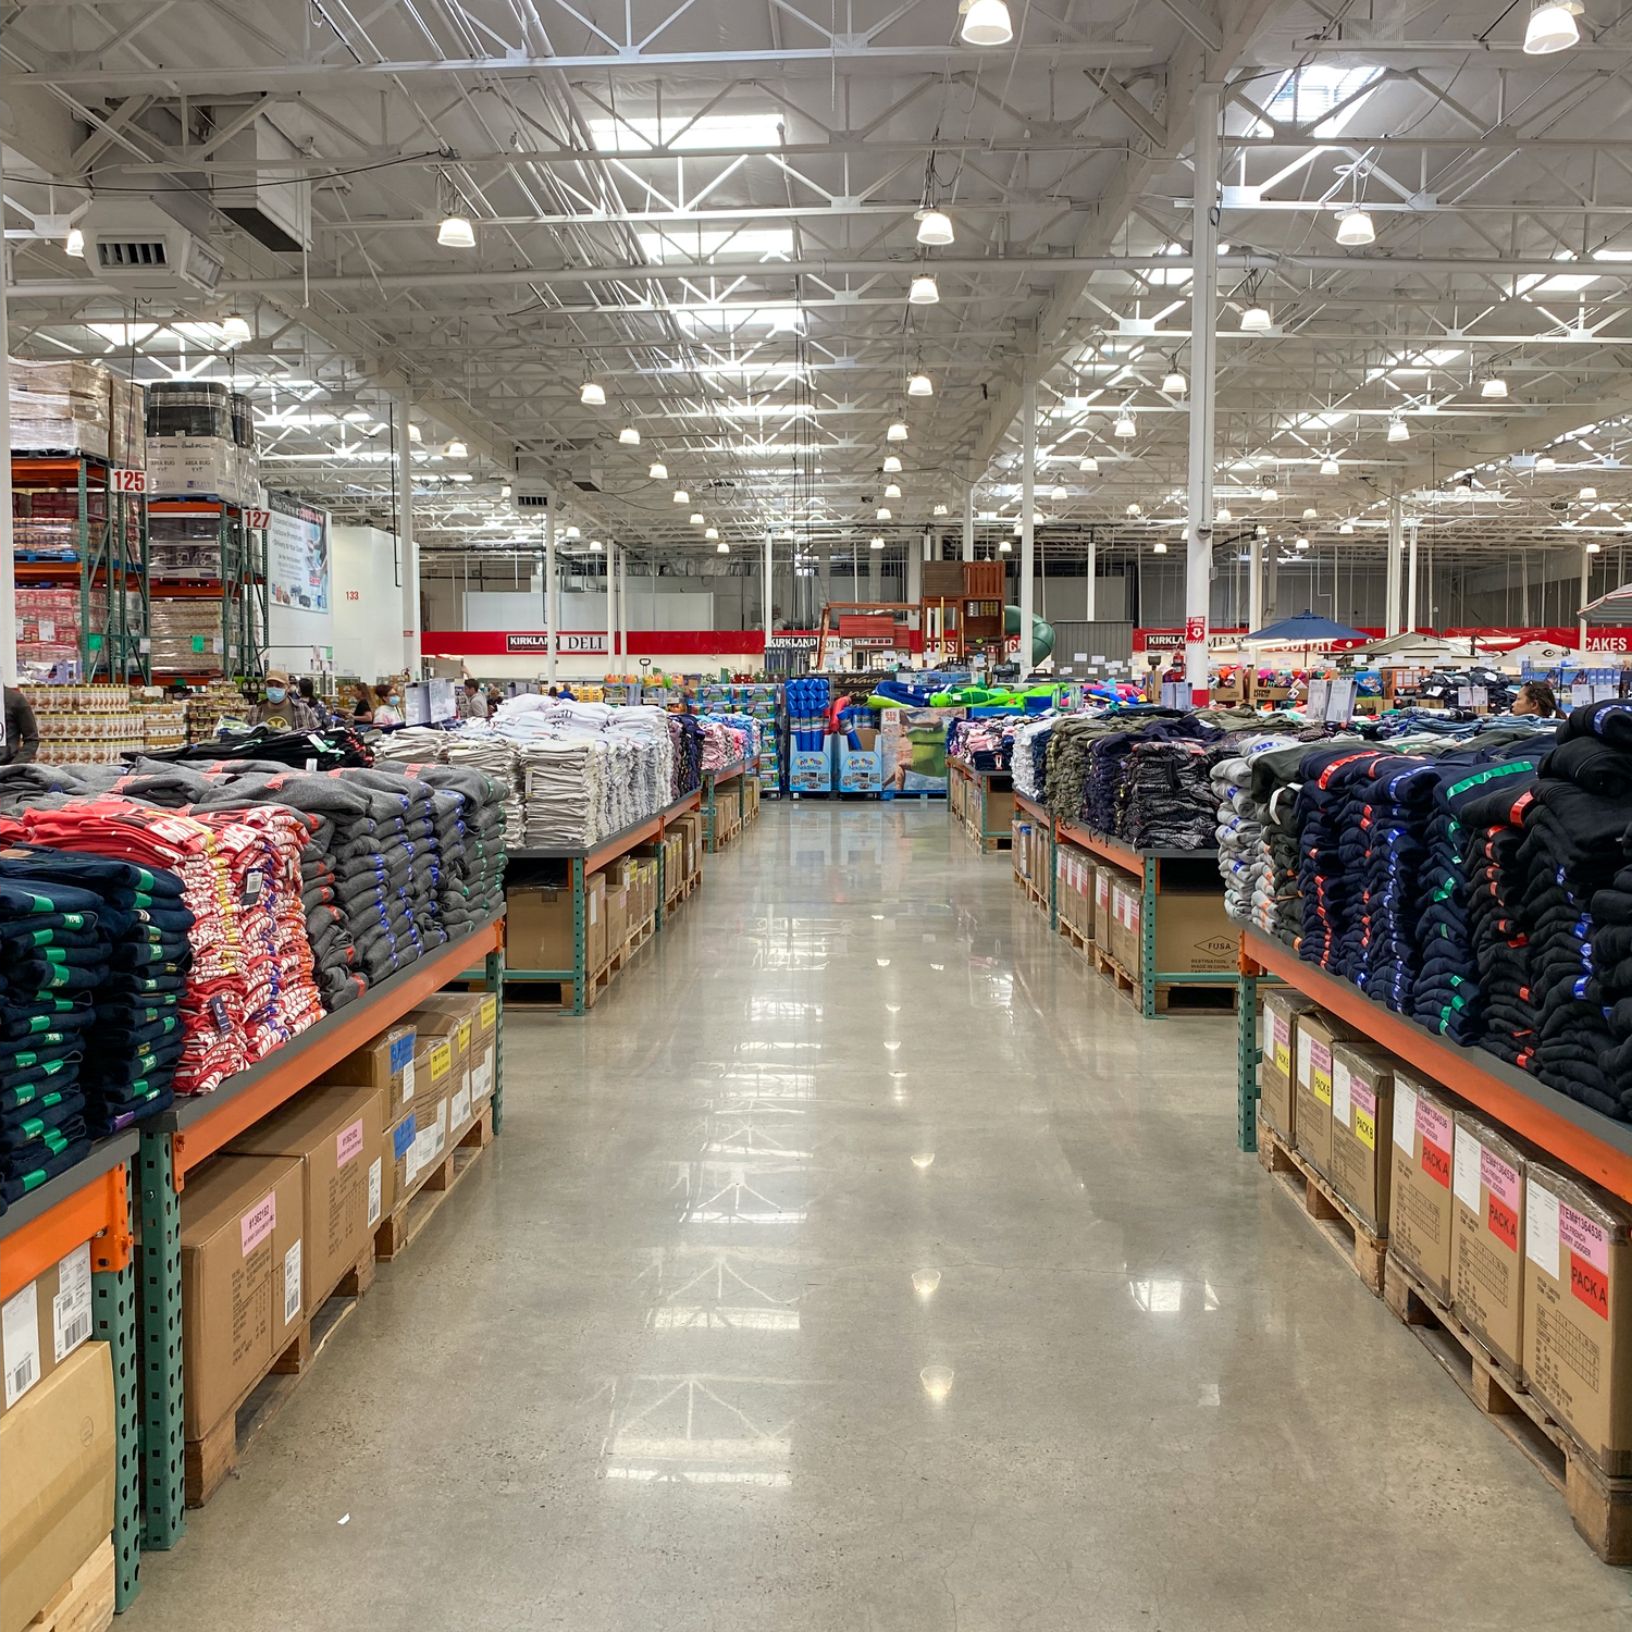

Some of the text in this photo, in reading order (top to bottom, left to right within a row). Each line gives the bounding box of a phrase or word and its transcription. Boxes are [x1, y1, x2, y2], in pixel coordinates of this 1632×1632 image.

[114, 471, 145, 491] 125
[245, 511, 271, 528] 127
[346, 591, 359, 600] 133
[510, 636, 603, 649] KIRKLAN DELI
[1148, 636, 1186, 645] KIRKLA
[1584, 637, 1627, 651] CAKES
[1357, 1115, 1369, 1135] PACK
[1422, 1145, 1449, 1178] PACK A
[1489, 1204, 1509, 1233] PACK
[1510, 1223, 1517, 1240] A
[1571, 1265, 1597, 1300] PACK
[1599, 1287, 1607, 1305] A
